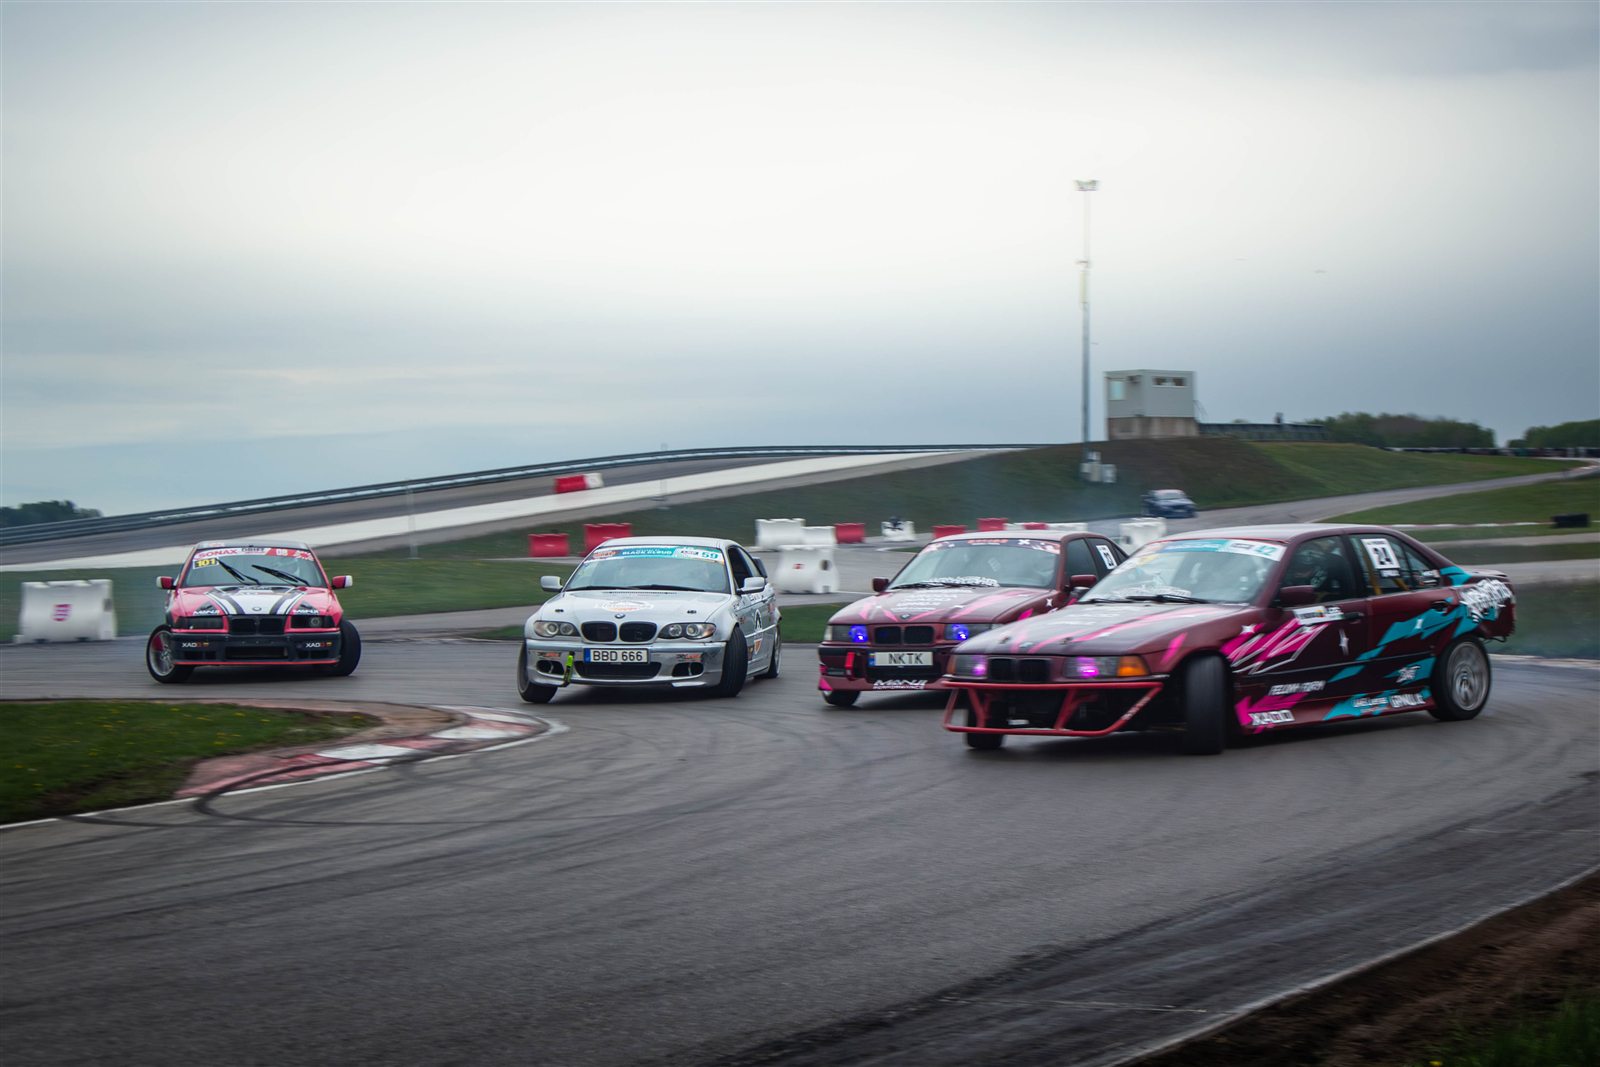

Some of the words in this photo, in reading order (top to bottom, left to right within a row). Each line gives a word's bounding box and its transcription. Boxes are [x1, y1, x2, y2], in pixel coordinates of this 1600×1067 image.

[198, 549, 238, 558] SONAX
[196, 558, 216, 567] 101
[592, 651, 618, 661] BBD
[621, 651, 643, 662] 666
[888, 653, 923, 664] NKTK
